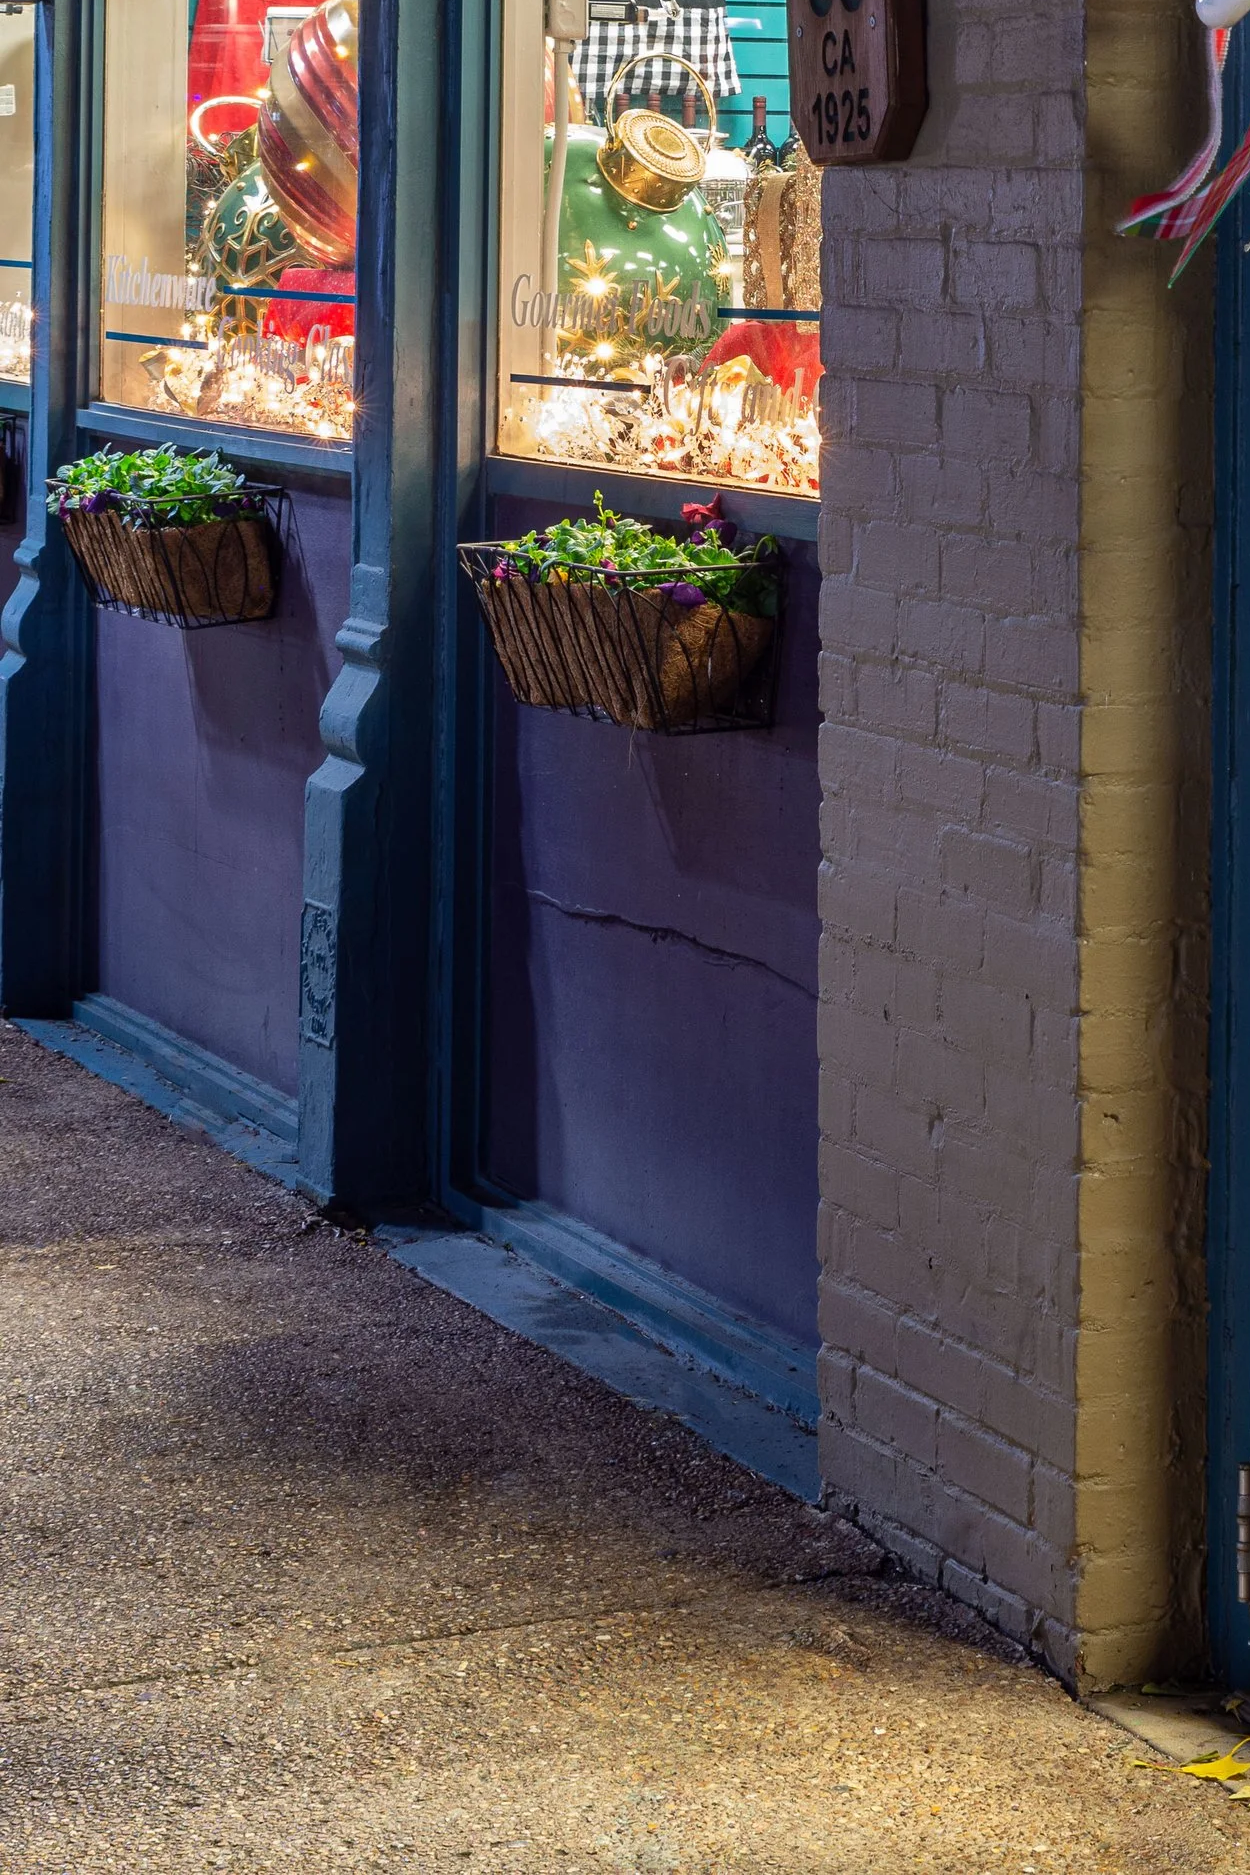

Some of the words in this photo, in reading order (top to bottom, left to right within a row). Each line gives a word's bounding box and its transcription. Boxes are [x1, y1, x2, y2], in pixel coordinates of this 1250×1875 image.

[822, 29, 855, 76] CA
[811, 88, 871, 145] 1925
[106, 255, 217, 312] Kitchenware
[510, 273, 620, 333] Gourmet
[629, 278, 713, 339] Foods
